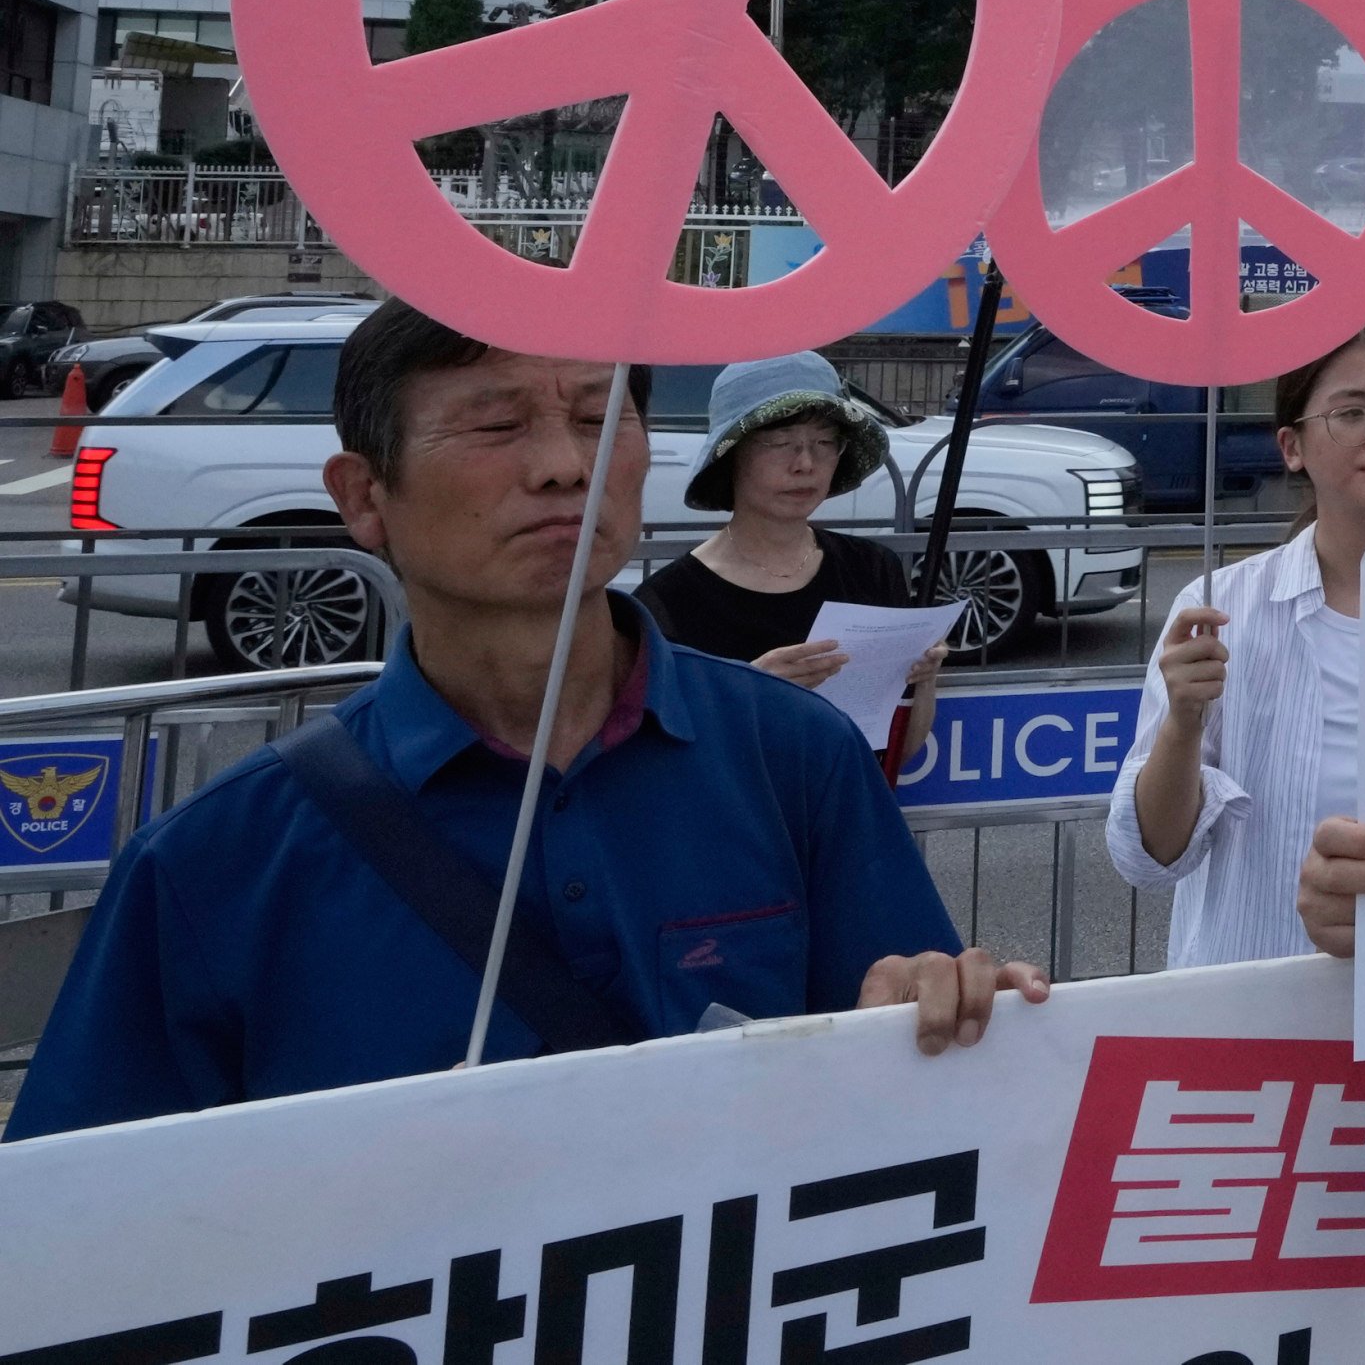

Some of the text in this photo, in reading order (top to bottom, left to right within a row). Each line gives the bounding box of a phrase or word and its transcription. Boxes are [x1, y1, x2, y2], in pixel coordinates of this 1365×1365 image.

[1254, 262, 1279, 277] 고충
[1243, 280, 1281, 294] 성폭력
[21, 820, 69, 833] POLICE
